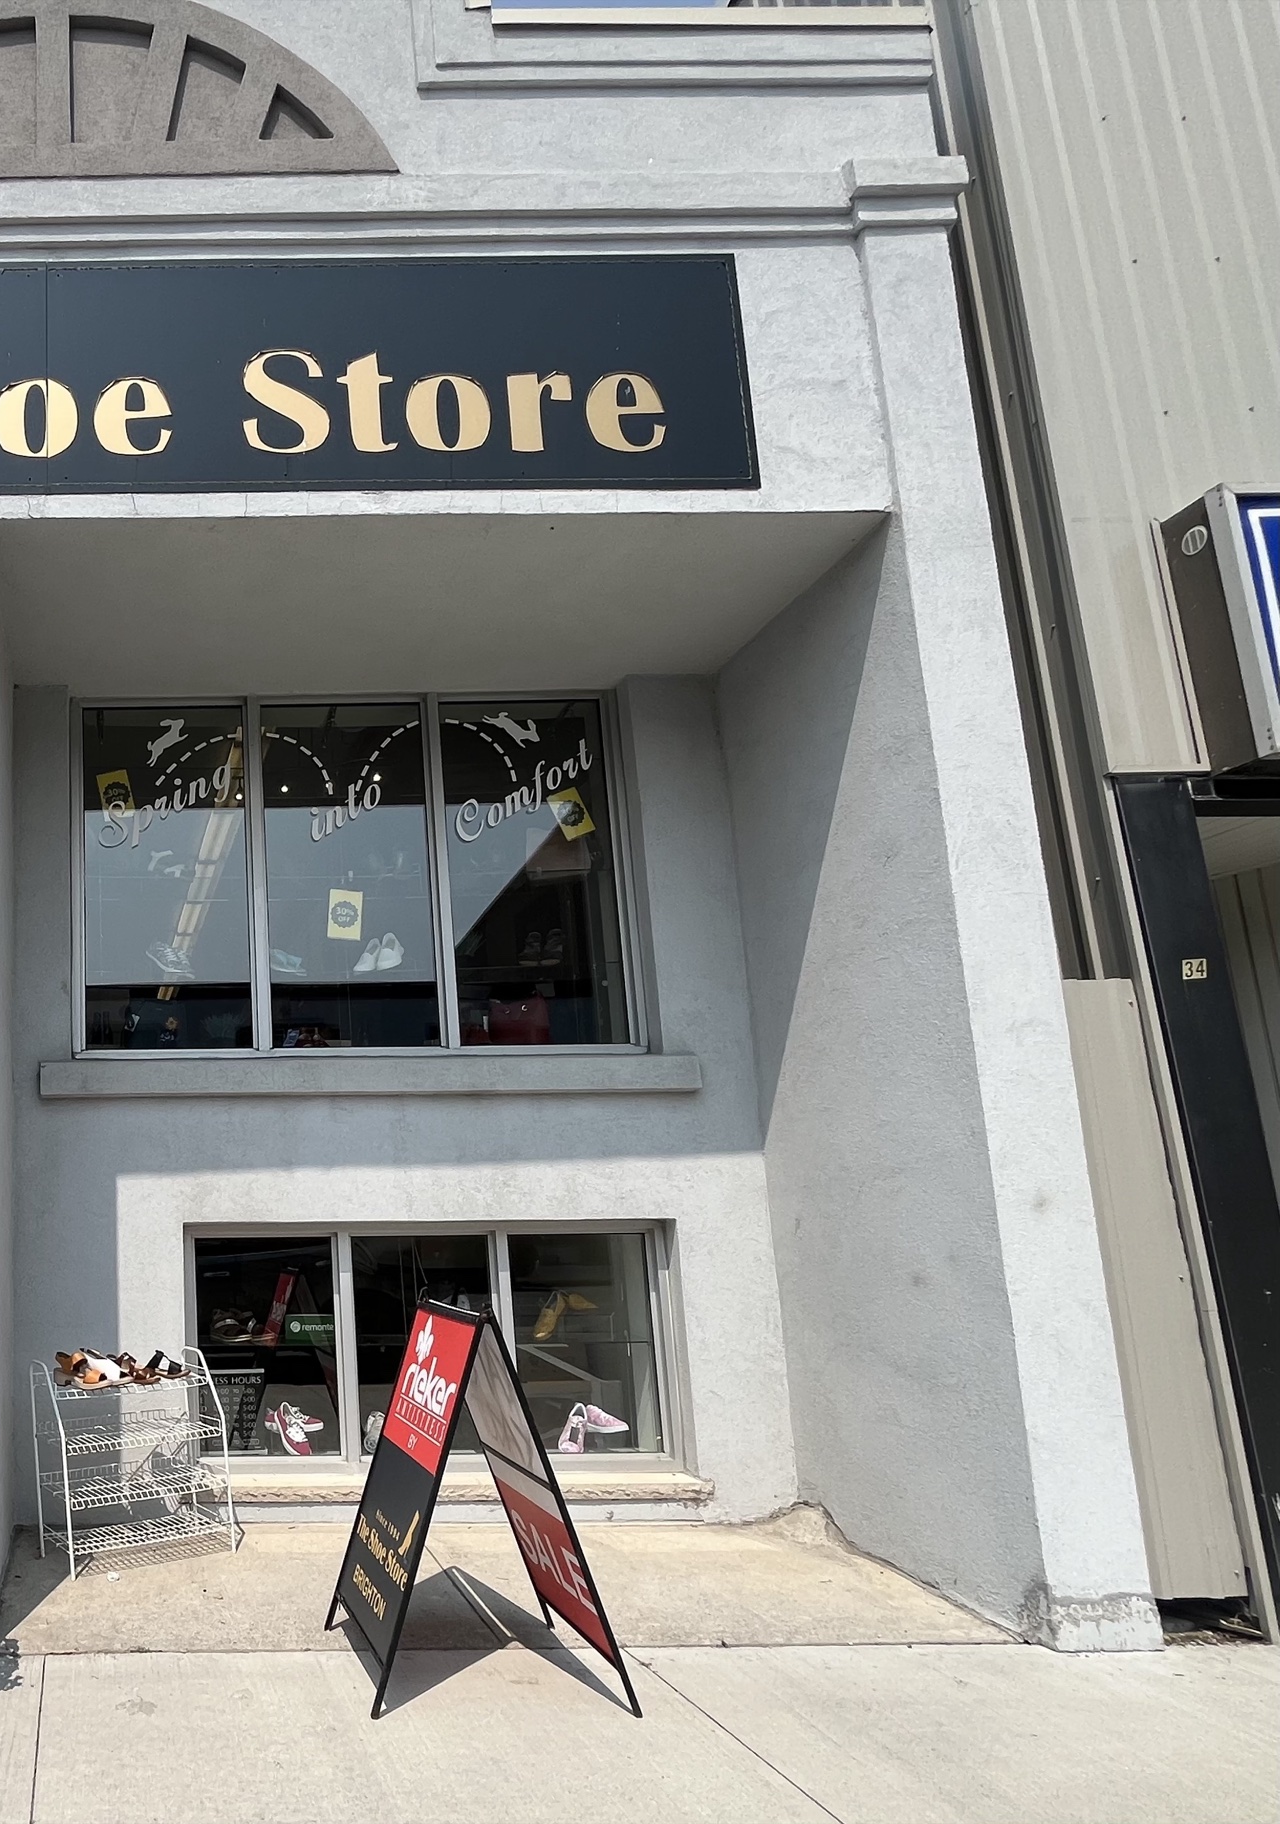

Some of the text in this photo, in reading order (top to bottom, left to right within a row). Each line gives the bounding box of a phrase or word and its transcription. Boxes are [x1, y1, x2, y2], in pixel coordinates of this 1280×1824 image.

[241, 347, 667, 454] Store
[97, 738, 593, 849] Spring into Comfort
[1184, 960, 1206, 978] 34
[301, 1323, 334, 1331] remonte
[231, 1376, 262, 1385] HOURS
[401, 1356, 458, 1418] rieker
[395, 1397, 446, 1442] ANTISTRESS
[407, 1433, 419, 1450] BY
[375, 1508, 389, 1529] Since
[356, 1512, 409, 1592] The Shoe Store
[511, 1508, 599, 1617] SALE
[352, 1563, 388, 1621] BRIGHTON
